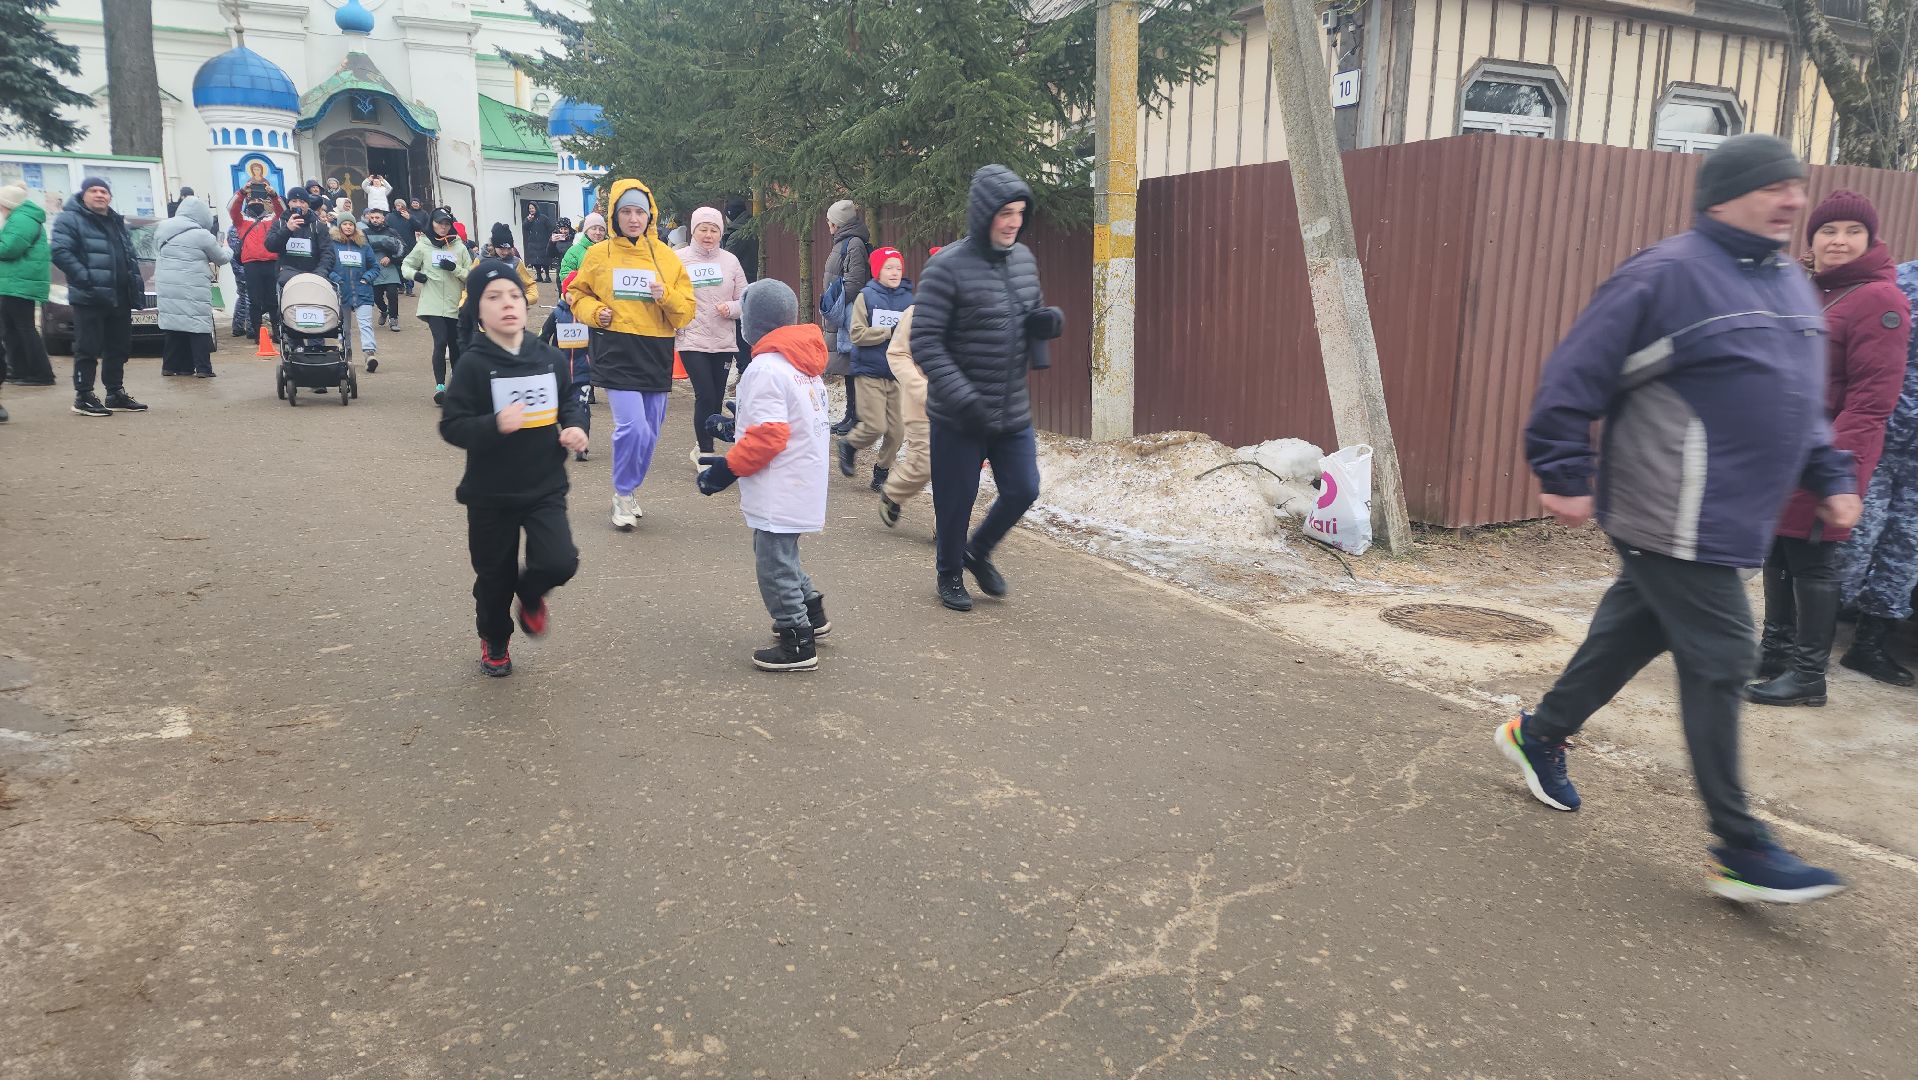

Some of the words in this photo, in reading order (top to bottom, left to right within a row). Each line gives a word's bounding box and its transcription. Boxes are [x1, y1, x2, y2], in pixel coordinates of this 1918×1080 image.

[1340, 80, 1351, 98] 10
[694, 267, 715, 277] 076
[622, 275, 648, 288] 075
[302, 312, 317, 320] 071
[563, 328, 582, 338] 237
